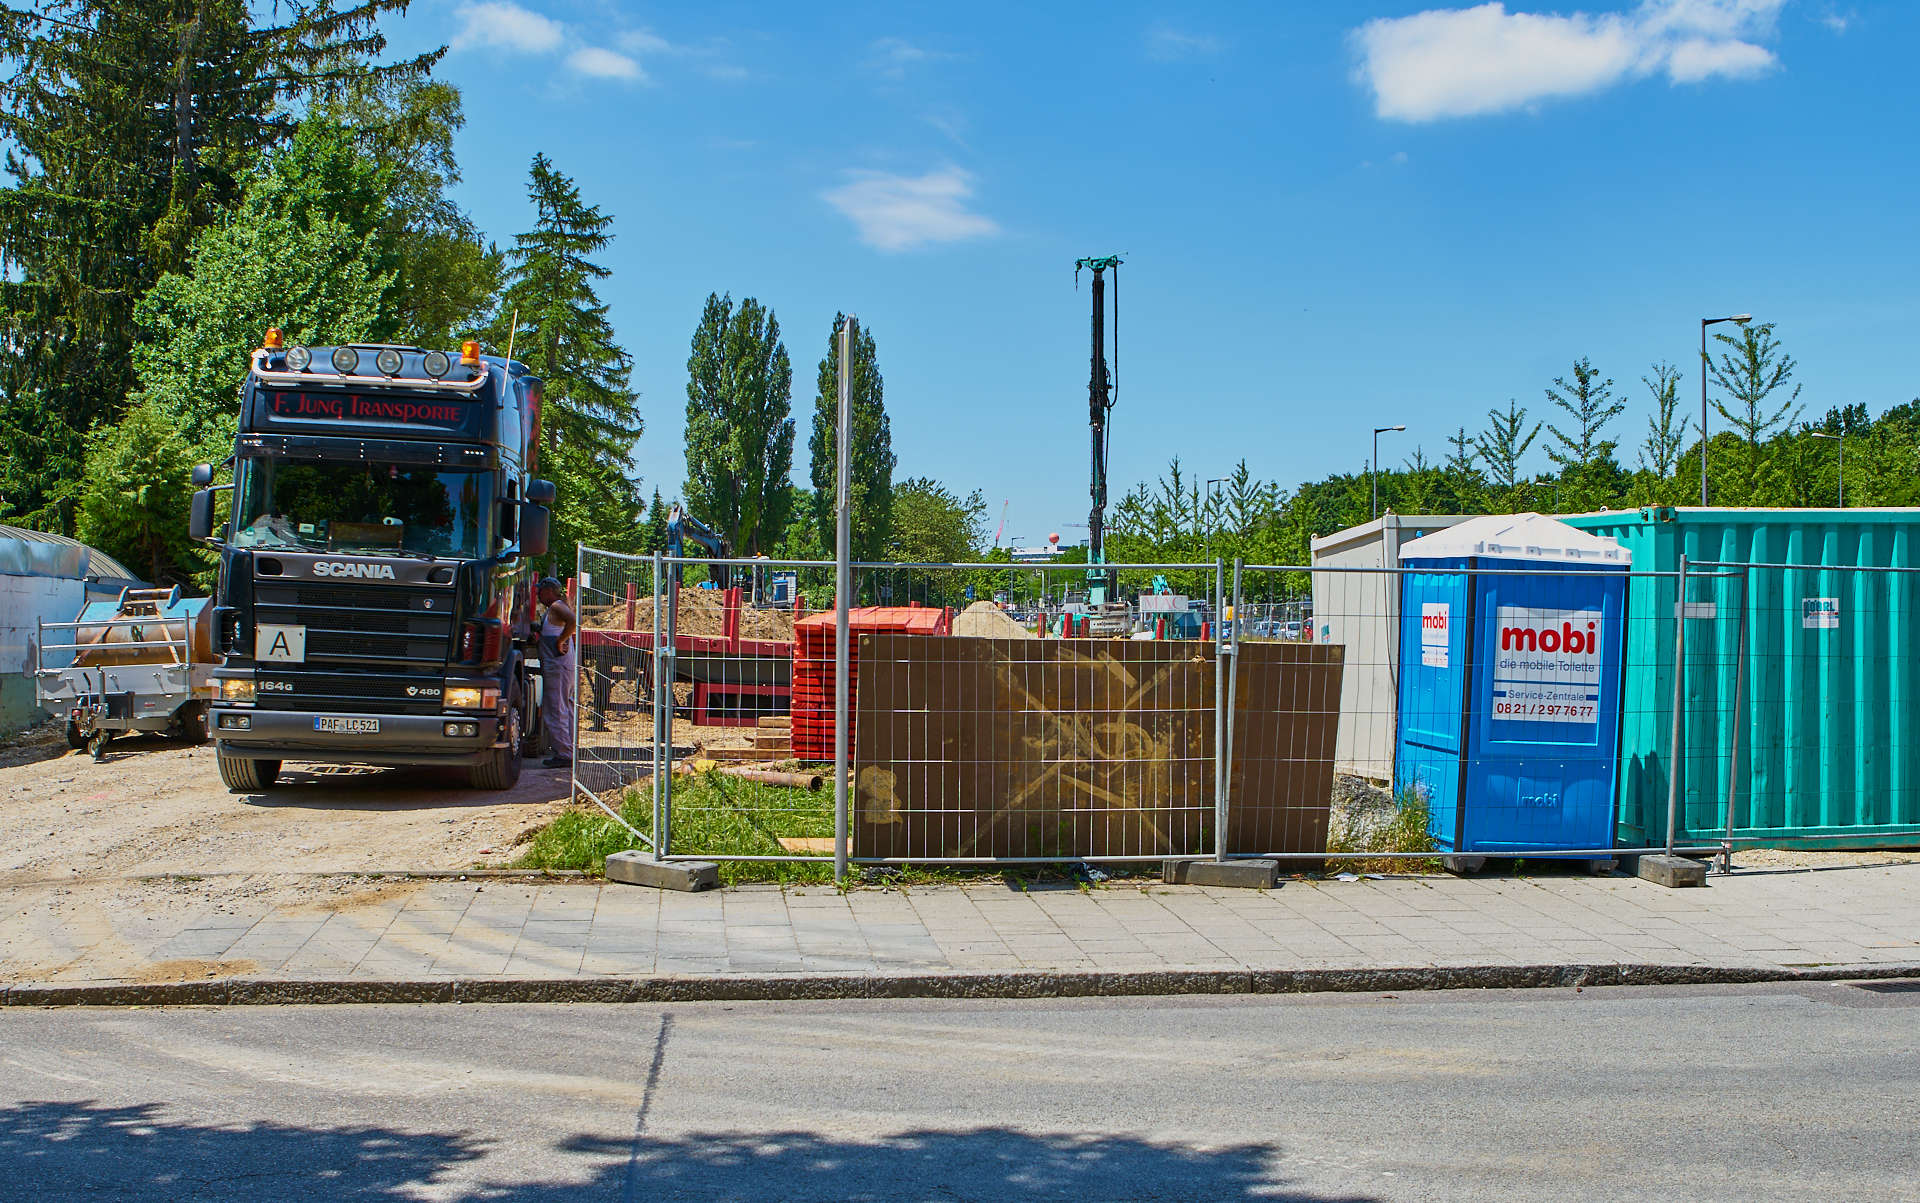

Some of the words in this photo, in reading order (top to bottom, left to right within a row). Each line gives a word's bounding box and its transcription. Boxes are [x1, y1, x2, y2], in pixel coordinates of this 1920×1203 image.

[274, 392, 290, 413] F.
[313, 561, 396, 580] SCANIA
[1143, 596, 1184, 610] MAC
[1422, 610, 1447, 630] mobi
[268, 631, 292, 656] A
[1501, 621, 1596, 655] mobi
[1500, 658, 1517, 669] die
[1519, 659, 1555, 671] mobile
[1558, 660, 1595, 673] Toilette
[259, 681, 294, 691] 164G
[419, 688, 441, 696] 480
[1508, 689, 1585, 702] Service-Zentrale
[321, 718, 340, 730] PAF
[346, 719, 359, 731] LC
[360, 720, 378, 731] 521
[1521, 792, 1558, 807] mobi
